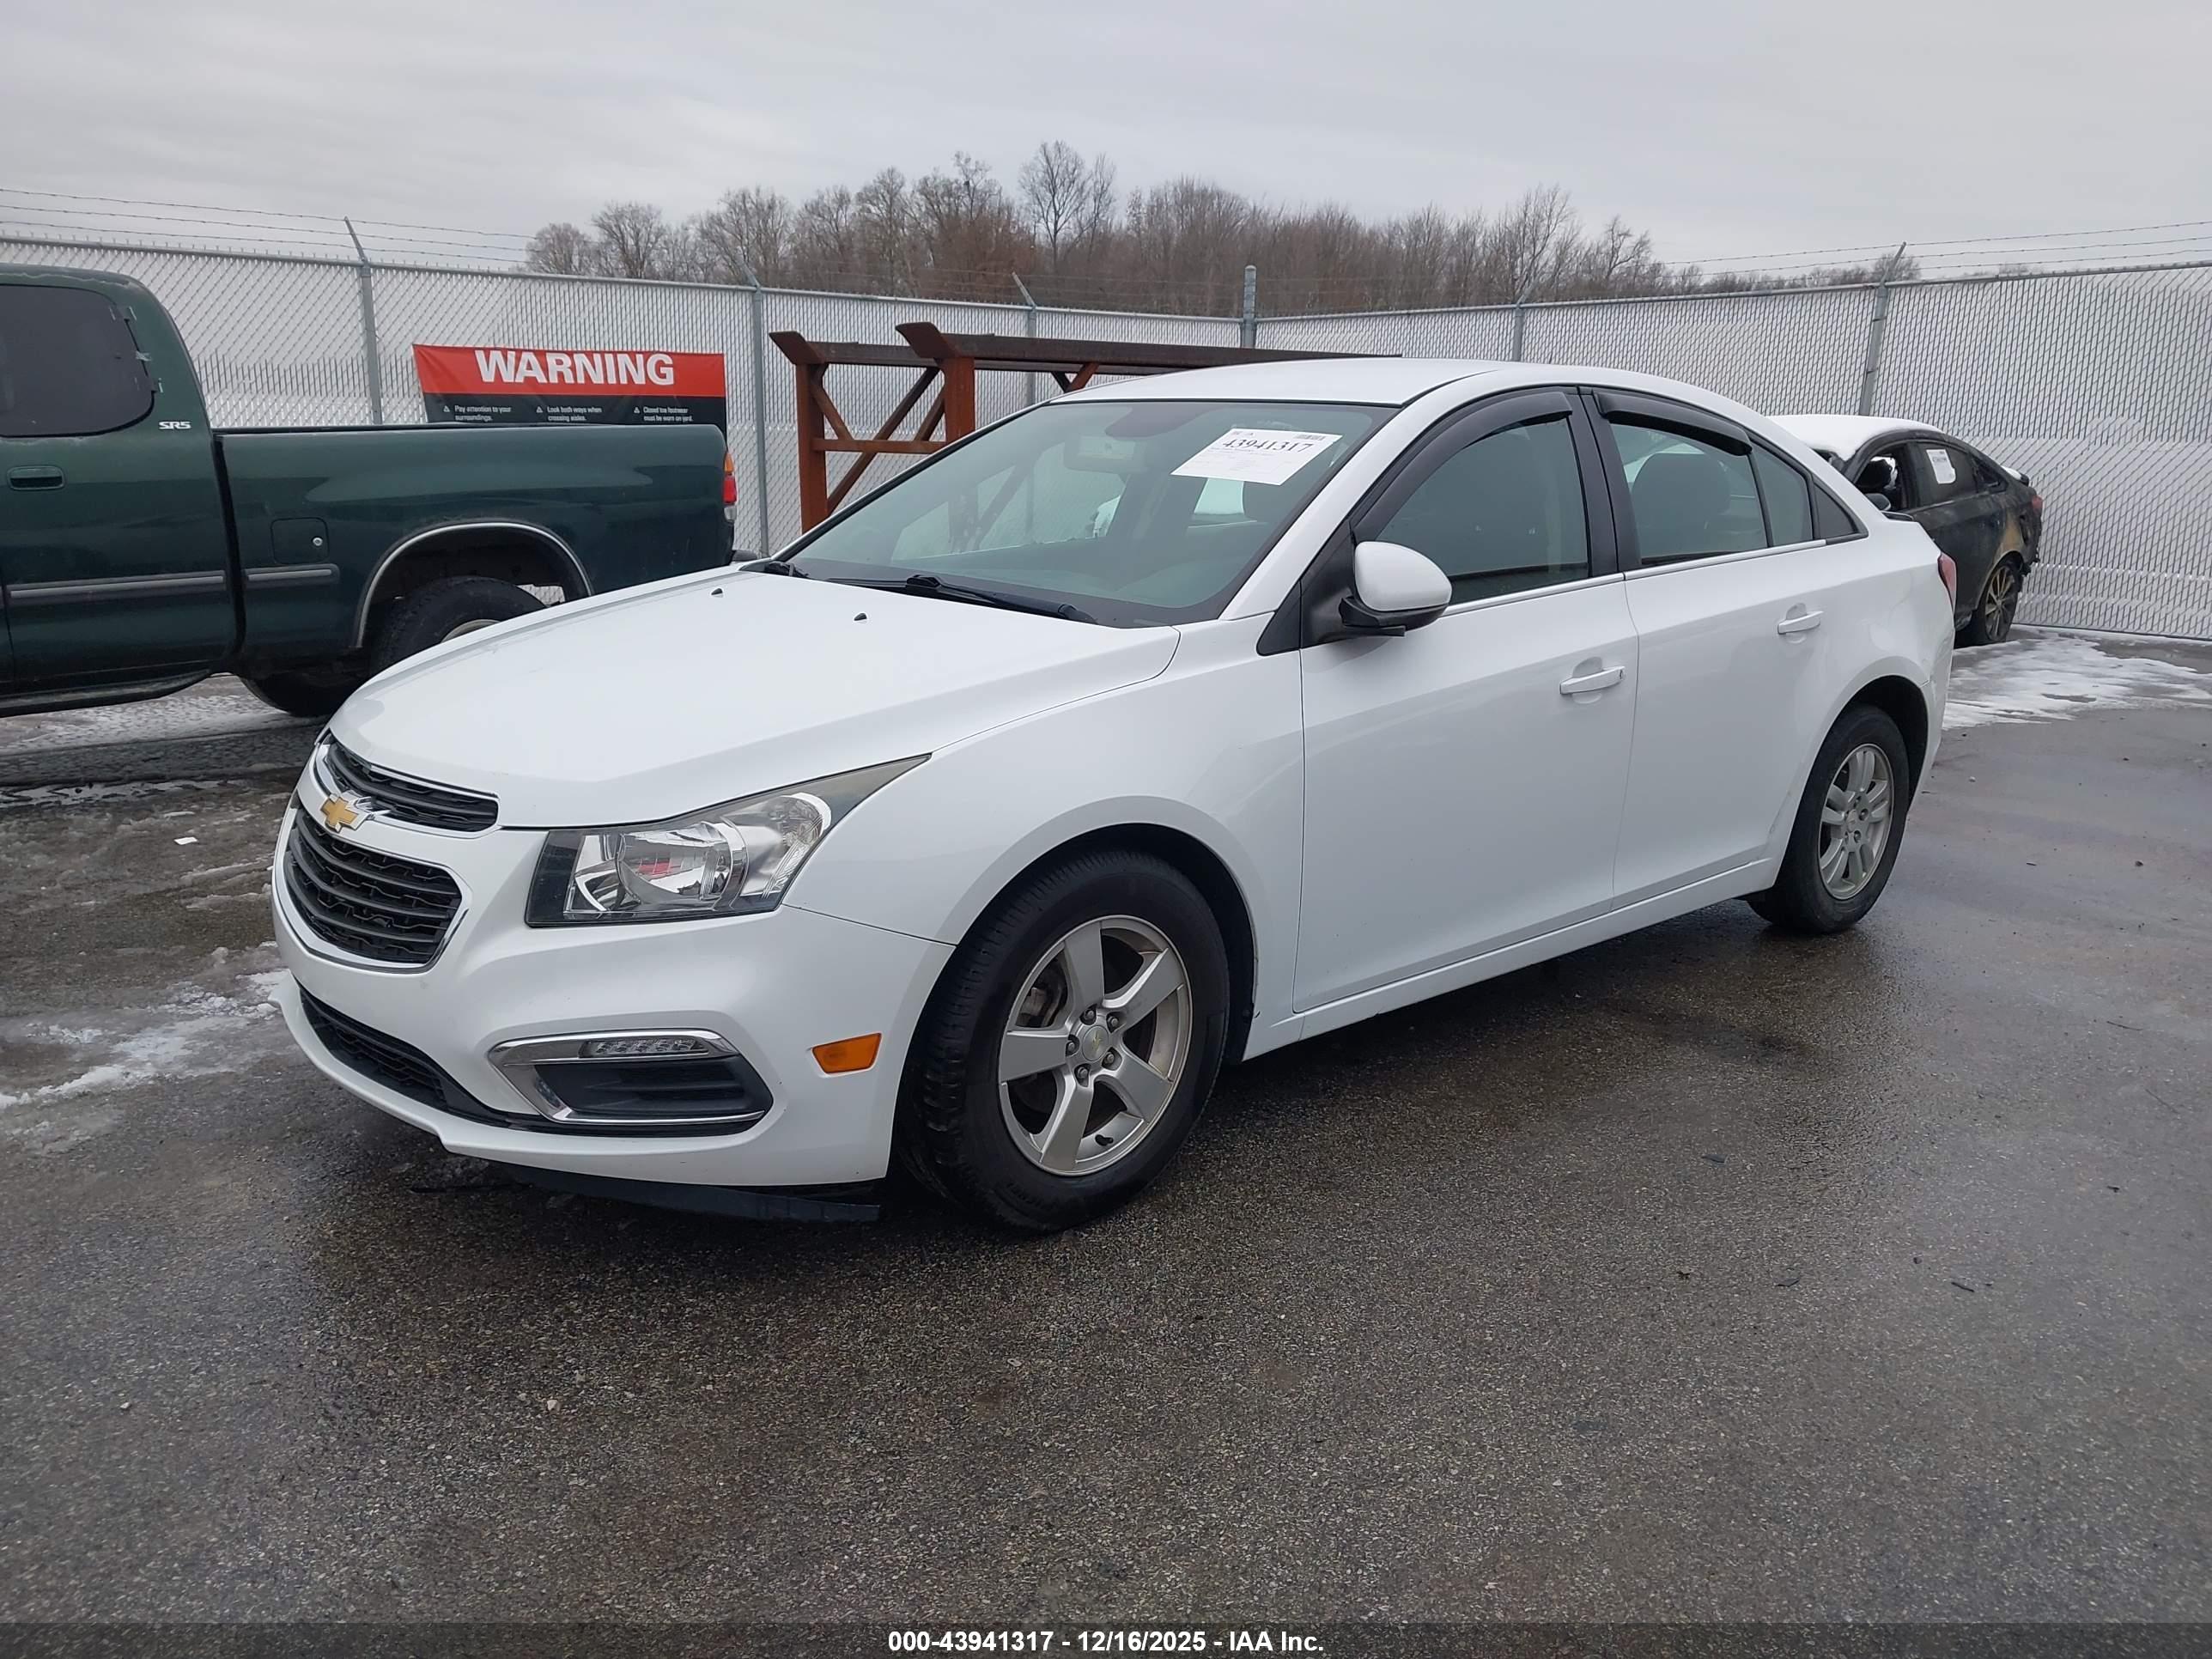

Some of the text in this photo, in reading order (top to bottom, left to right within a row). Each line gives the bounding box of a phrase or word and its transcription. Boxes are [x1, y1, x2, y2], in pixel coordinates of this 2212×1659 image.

[475, 349, 674, 385] WARNING
[159, 421, 191, 429] SR5
[1223, 439, 1314, 452] 43941317
